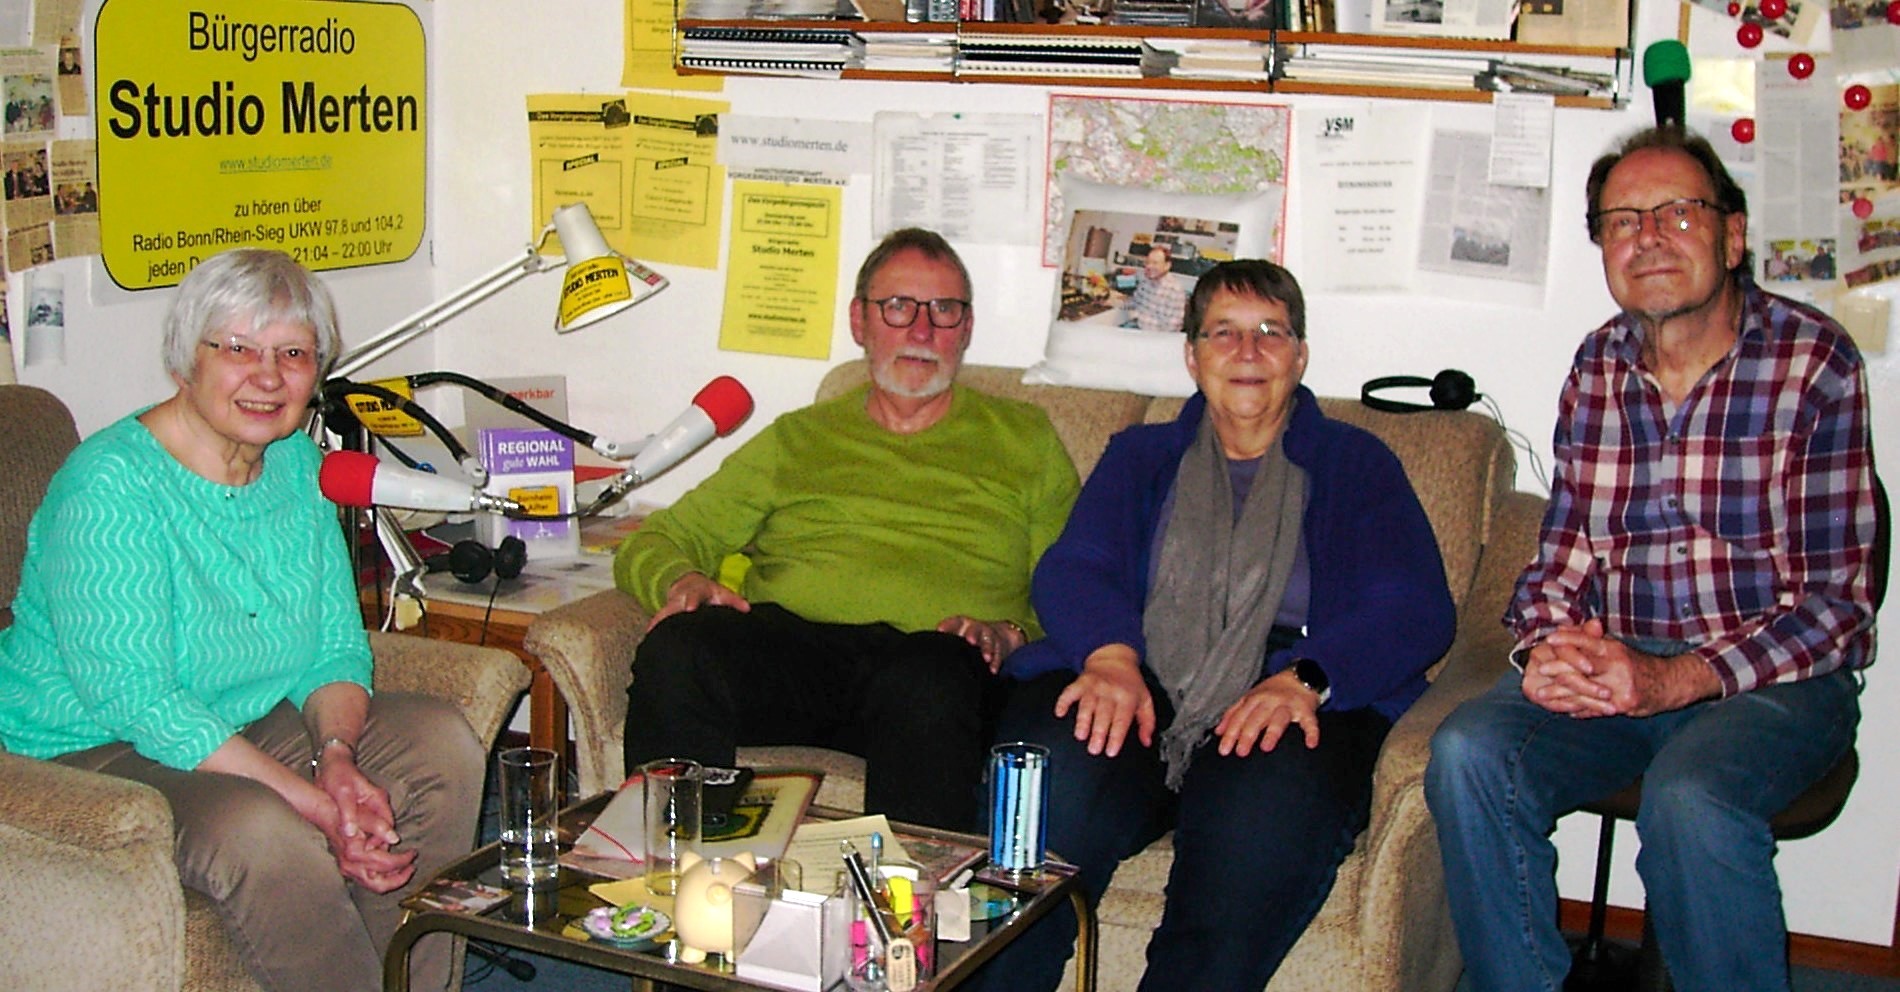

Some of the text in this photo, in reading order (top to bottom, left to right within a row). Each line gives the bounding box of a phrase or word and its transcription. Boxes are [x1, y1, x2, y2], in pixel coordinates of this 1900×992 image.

[189, 11, 355, 62] Bürgerradio
[108, 79, 418, 139] Studio Merten
[1324, 117, 1355, 132] VSM
[730, 135, 849, 153] www.studiomerten.de
[219, 155, 333, 173] www.studiomerten.de
[234, 197, 322, 217] zu hören über
[132, 232, 174, 252] Radio
[176, 222, 286, 249] Bonn/Rhein-Sieg
[288, 220, 323, 239] UKW
[351, 216, 371, 233] und
[374, 239, 393, 255] Uhr
[752, 245, 816, 257] Studio Merten
[147, 259, 186, 282] jeden
[498, 439, 566, 456] REGIONAL
[502, 454, 561, 472] gute WAHL
